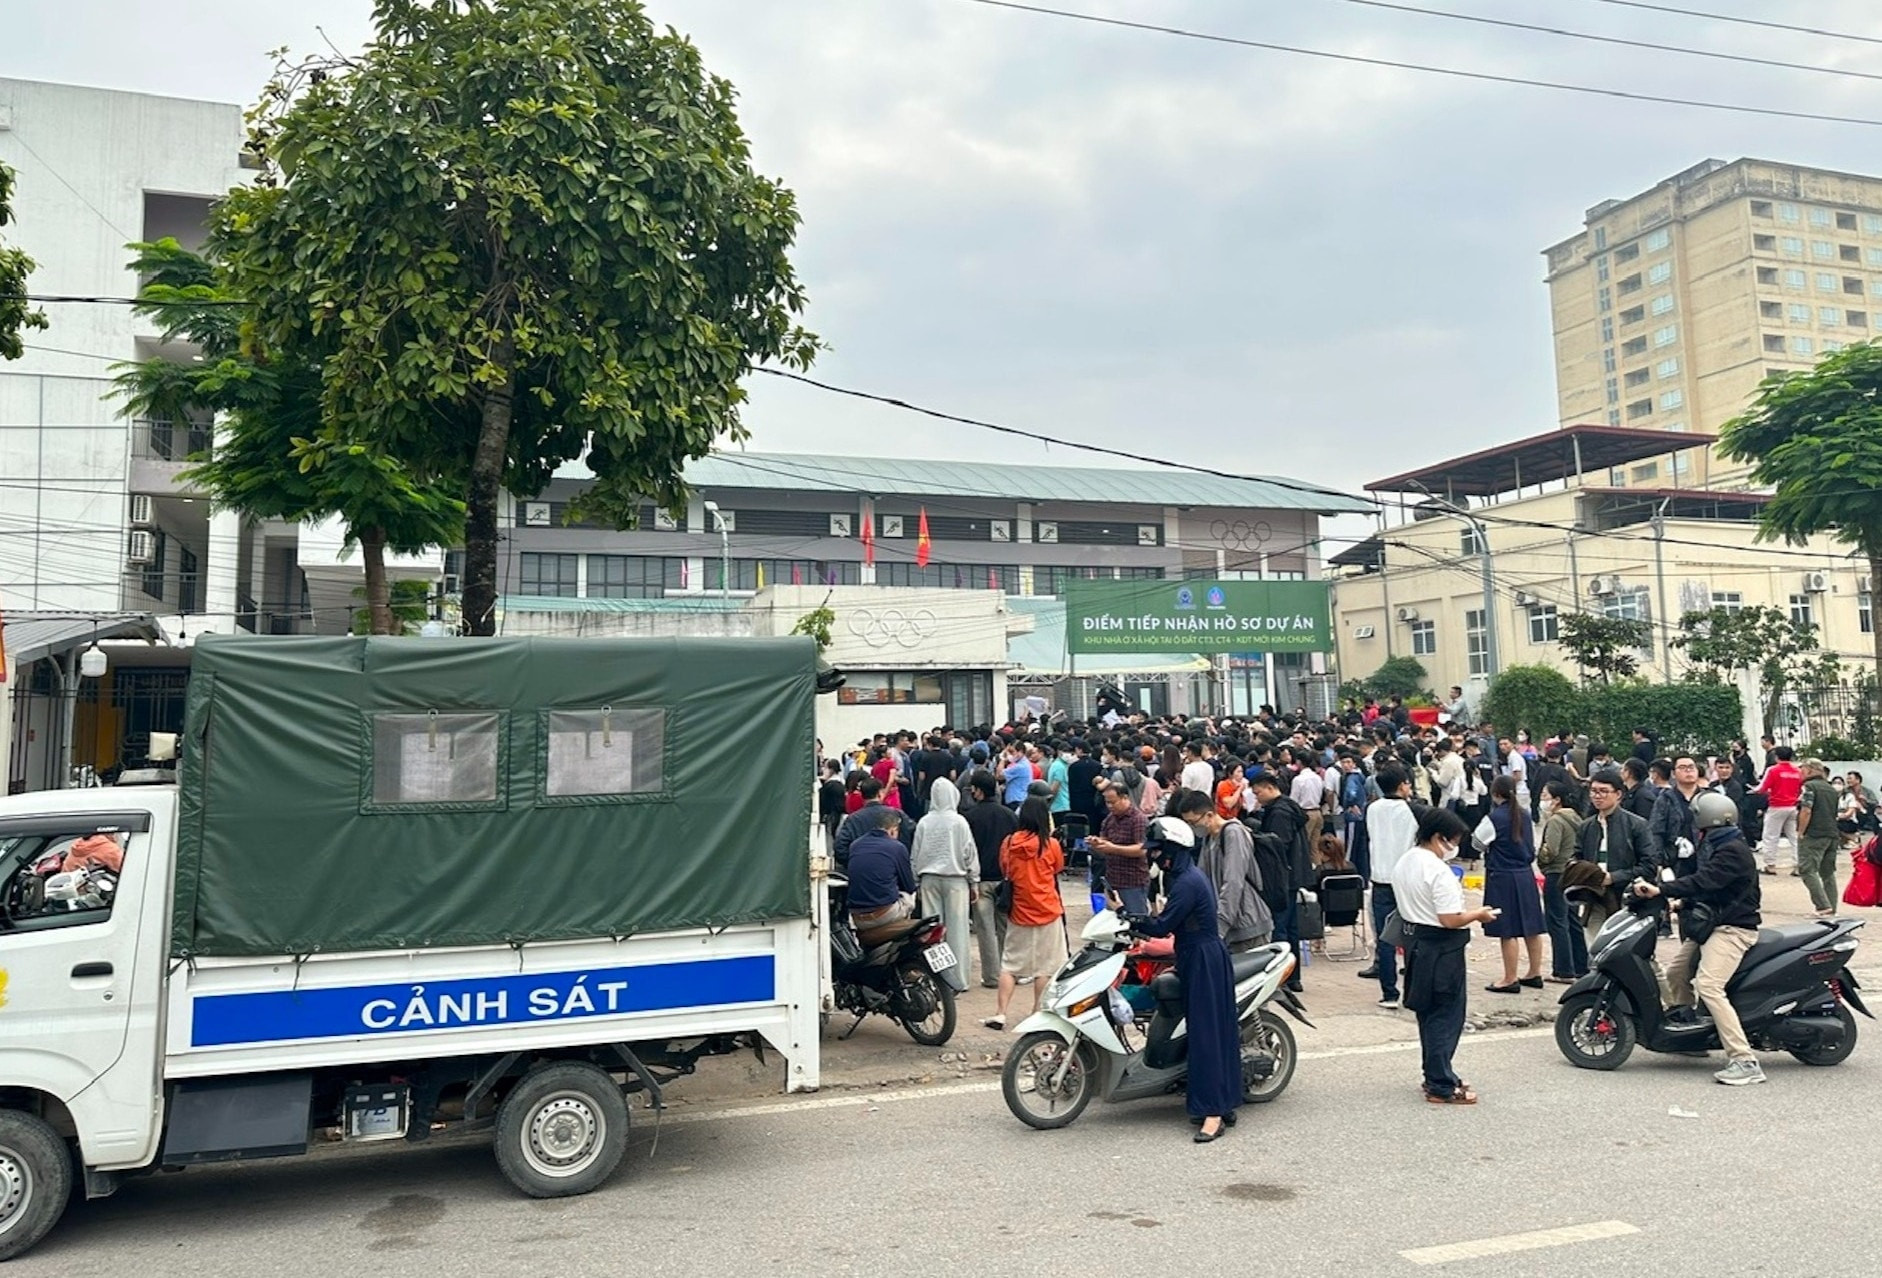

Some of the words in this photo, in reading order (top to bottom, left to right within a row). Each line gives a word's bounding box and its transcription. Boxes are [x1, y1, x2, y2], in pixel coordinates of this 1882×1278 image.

[1127, 613, 1161, 630] TIẾP
[1165, 614, 1209, 633] NHẬN
[1214, 613, 1237, 630] HỒ
[1241, 616, 1262, 630] SƠ
[1266, 616, 1290, 632] DỰ
[1293, 614, 1314, 629] ÁN
[1287, 635, 1316, 644] CHUNG
[361, 985, 508, 1029] CẢNH
[528, 975, 627, 1016] SÁT
